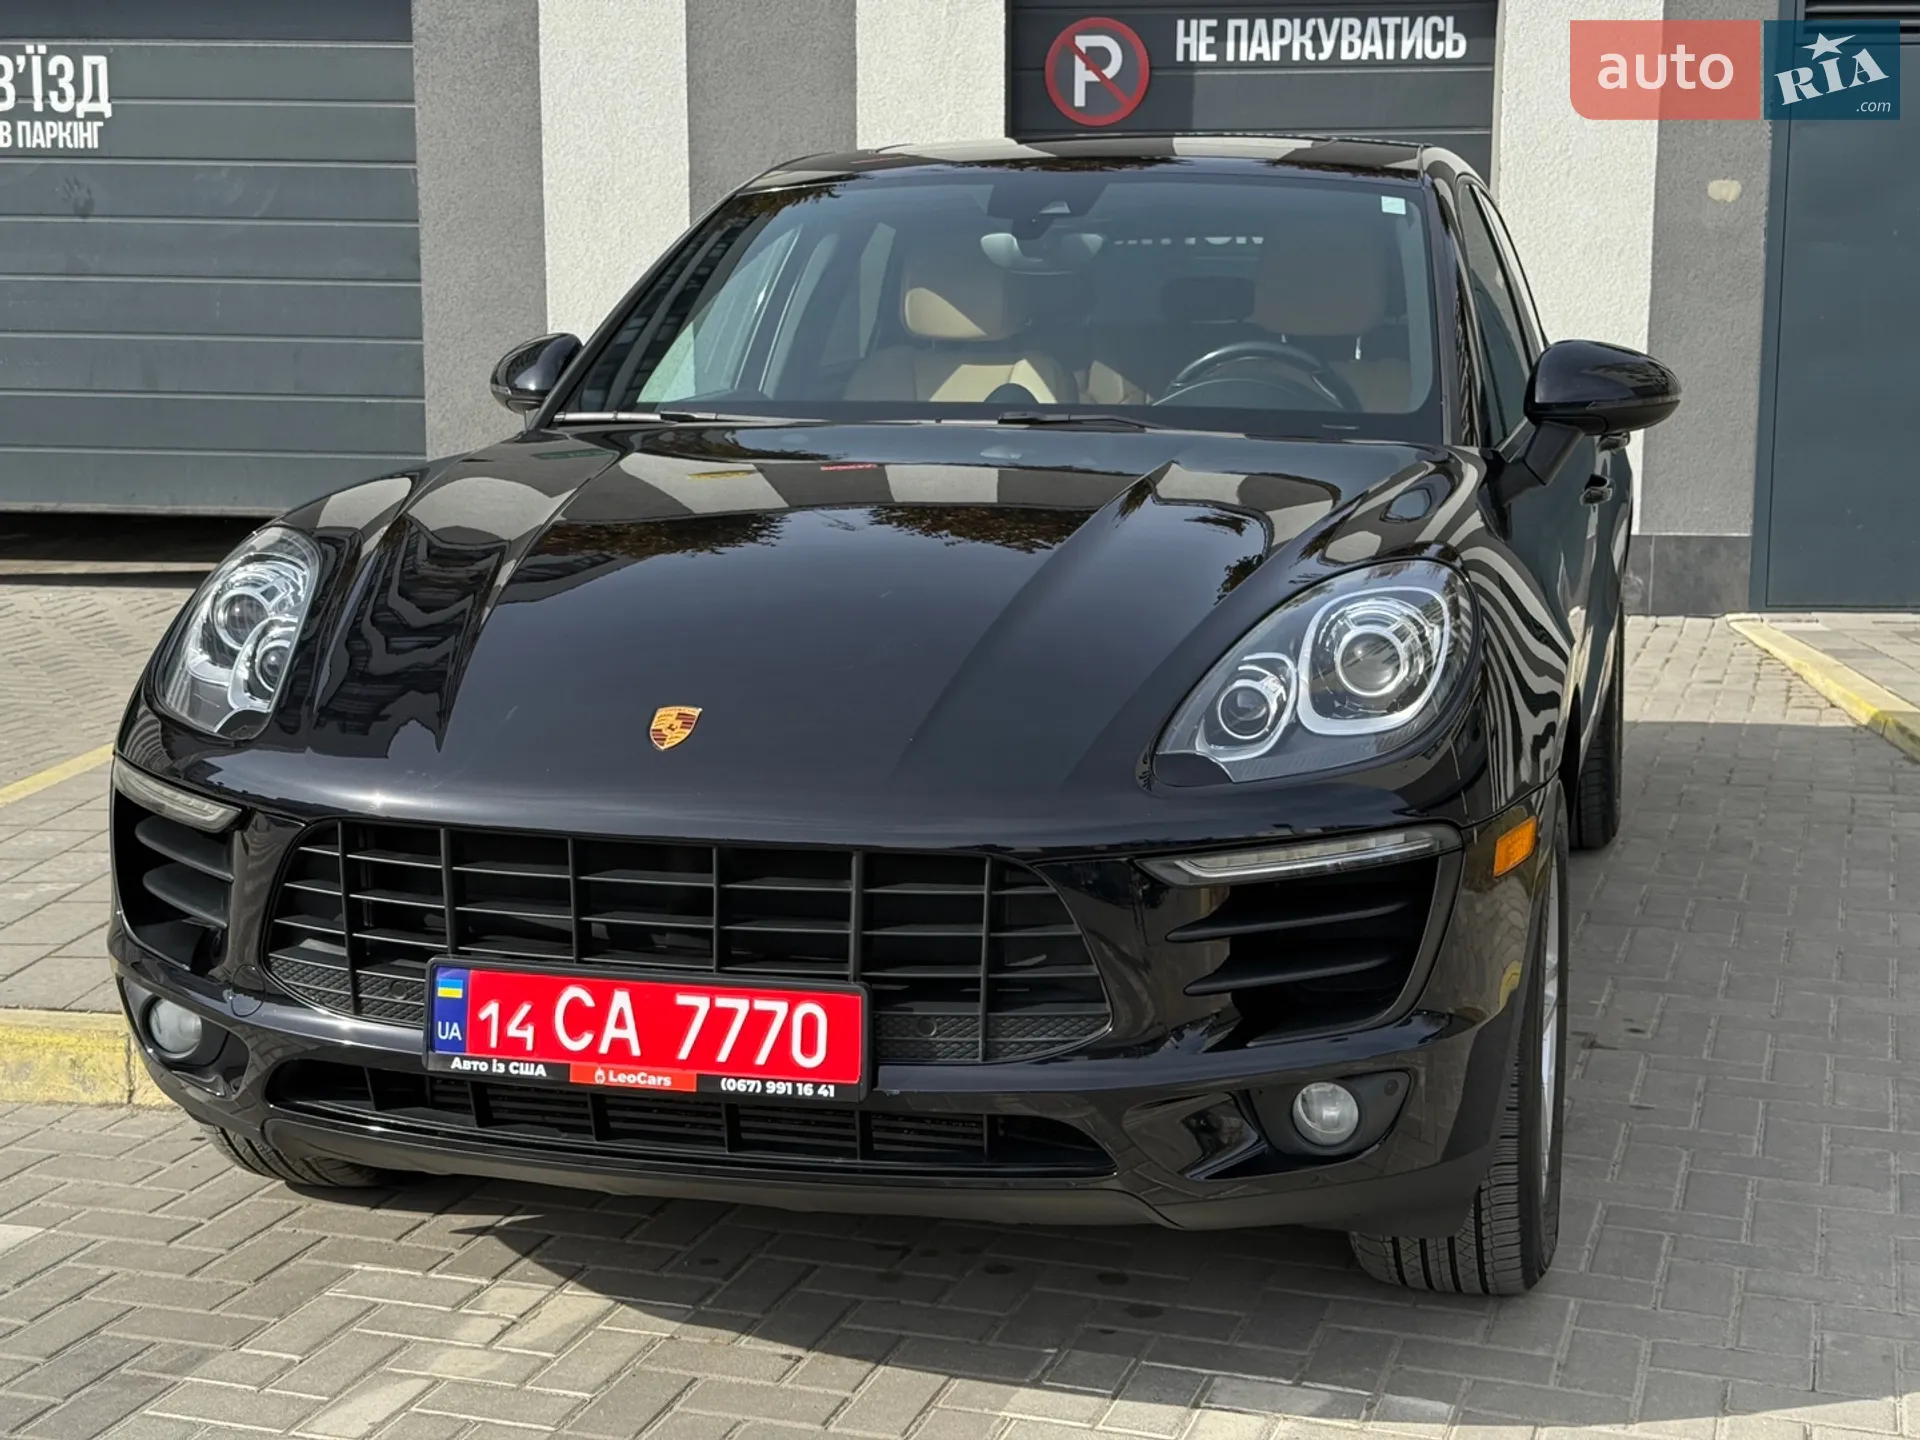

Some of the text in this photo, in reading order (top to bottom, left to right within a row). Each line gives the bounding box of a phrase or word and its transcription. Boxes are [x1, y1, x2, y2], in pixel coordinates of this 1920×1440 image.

[1175, 15, 1467, 62] НЕ ПАРКУВАТИСЬ
[0, 121, 104, 149] В ПАРКІНГ
[437, 1021, 462, 1041] UA
[478, 985, 828, 1069] 14 CA 7770
[451, 1056, 547, 1077] Авто із США
[608, 1069, 672, 1087] LeoCars
[720, 1077, 835, 1098] (067) 991 16 41
